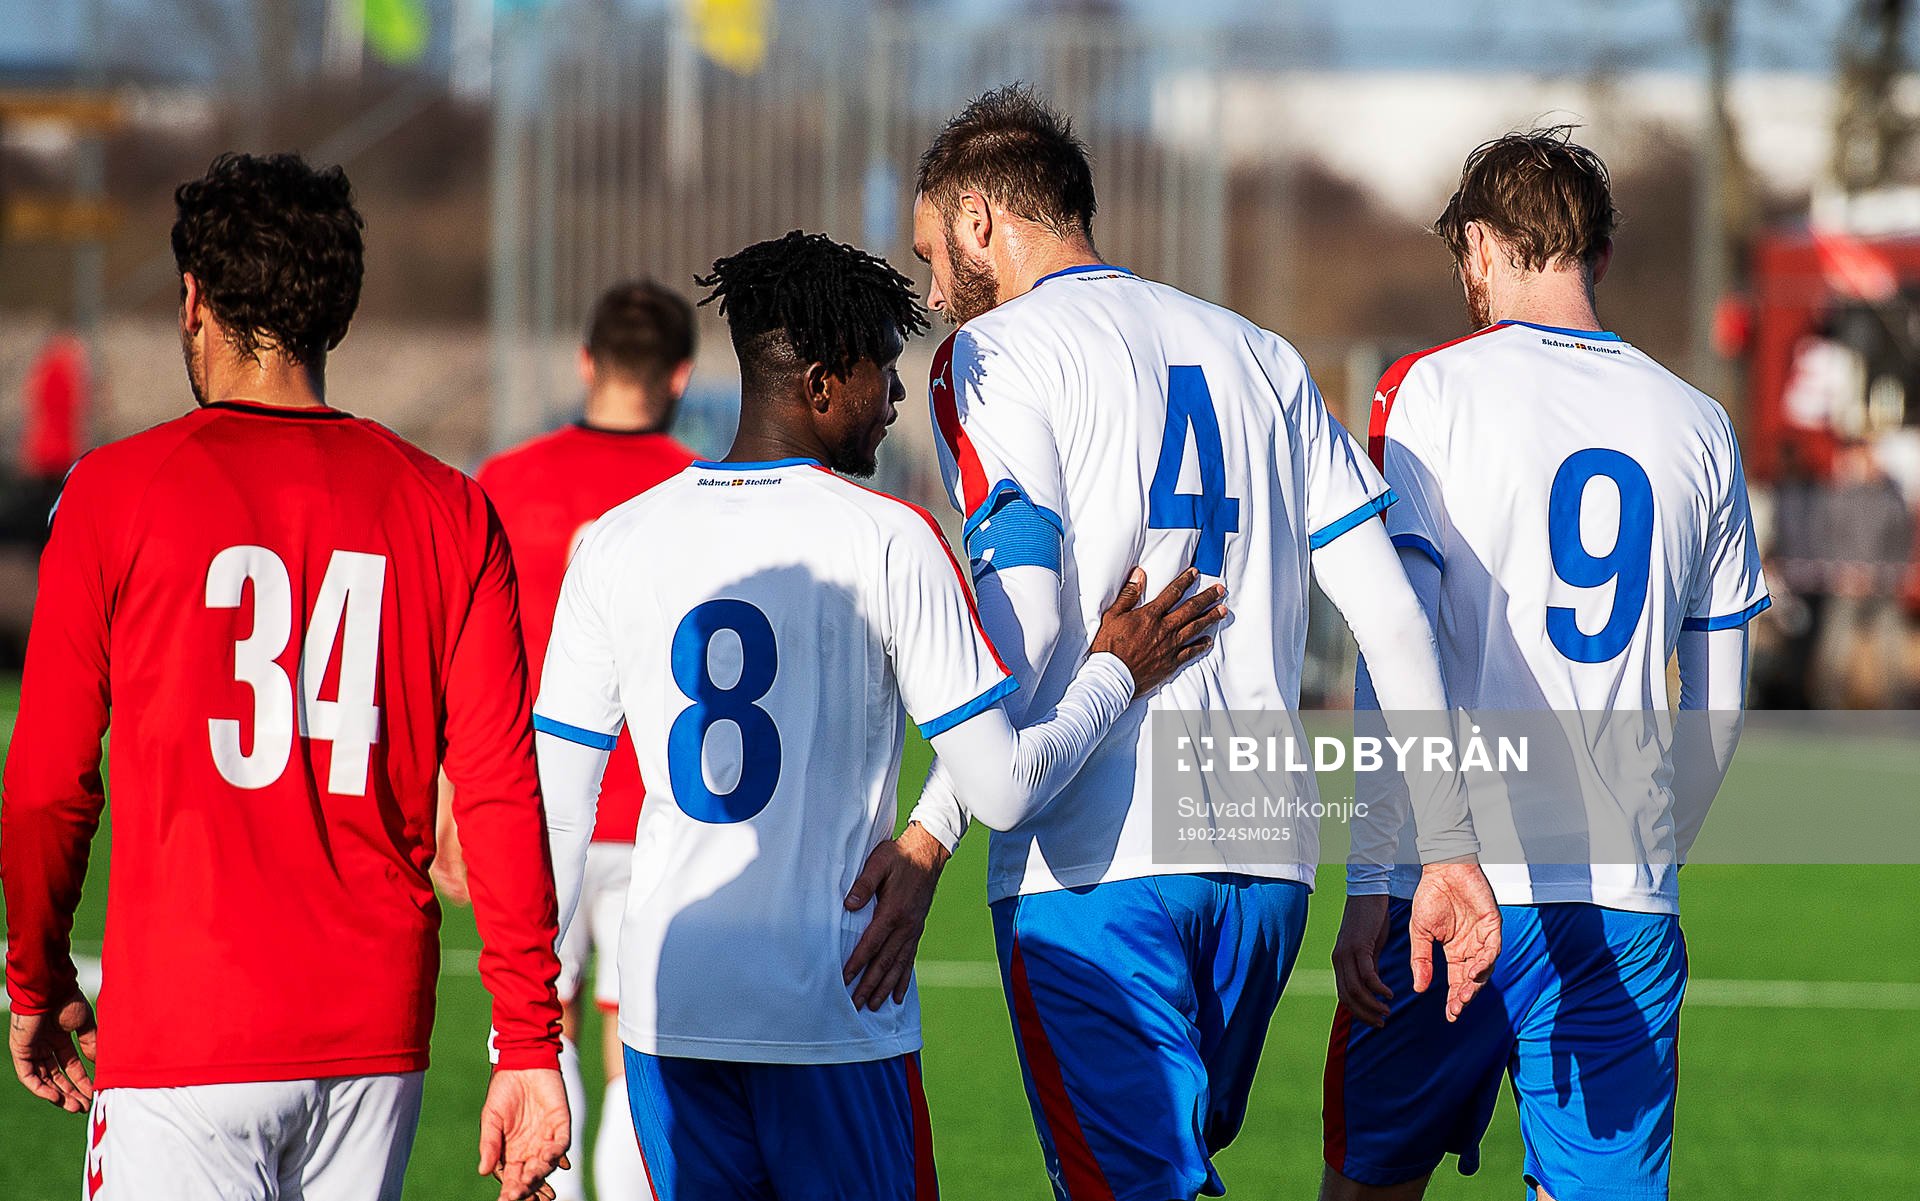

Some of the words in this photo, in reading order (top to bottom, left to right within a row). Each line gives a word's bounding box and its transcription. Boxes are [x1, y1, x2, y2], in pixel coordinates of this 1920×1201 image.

[1148, 365, 1240, 578] 4
[1546, 447, 1655, 664] 9
[205, 545, 387, 797] 34
[667, 600, 780, 825] 8
